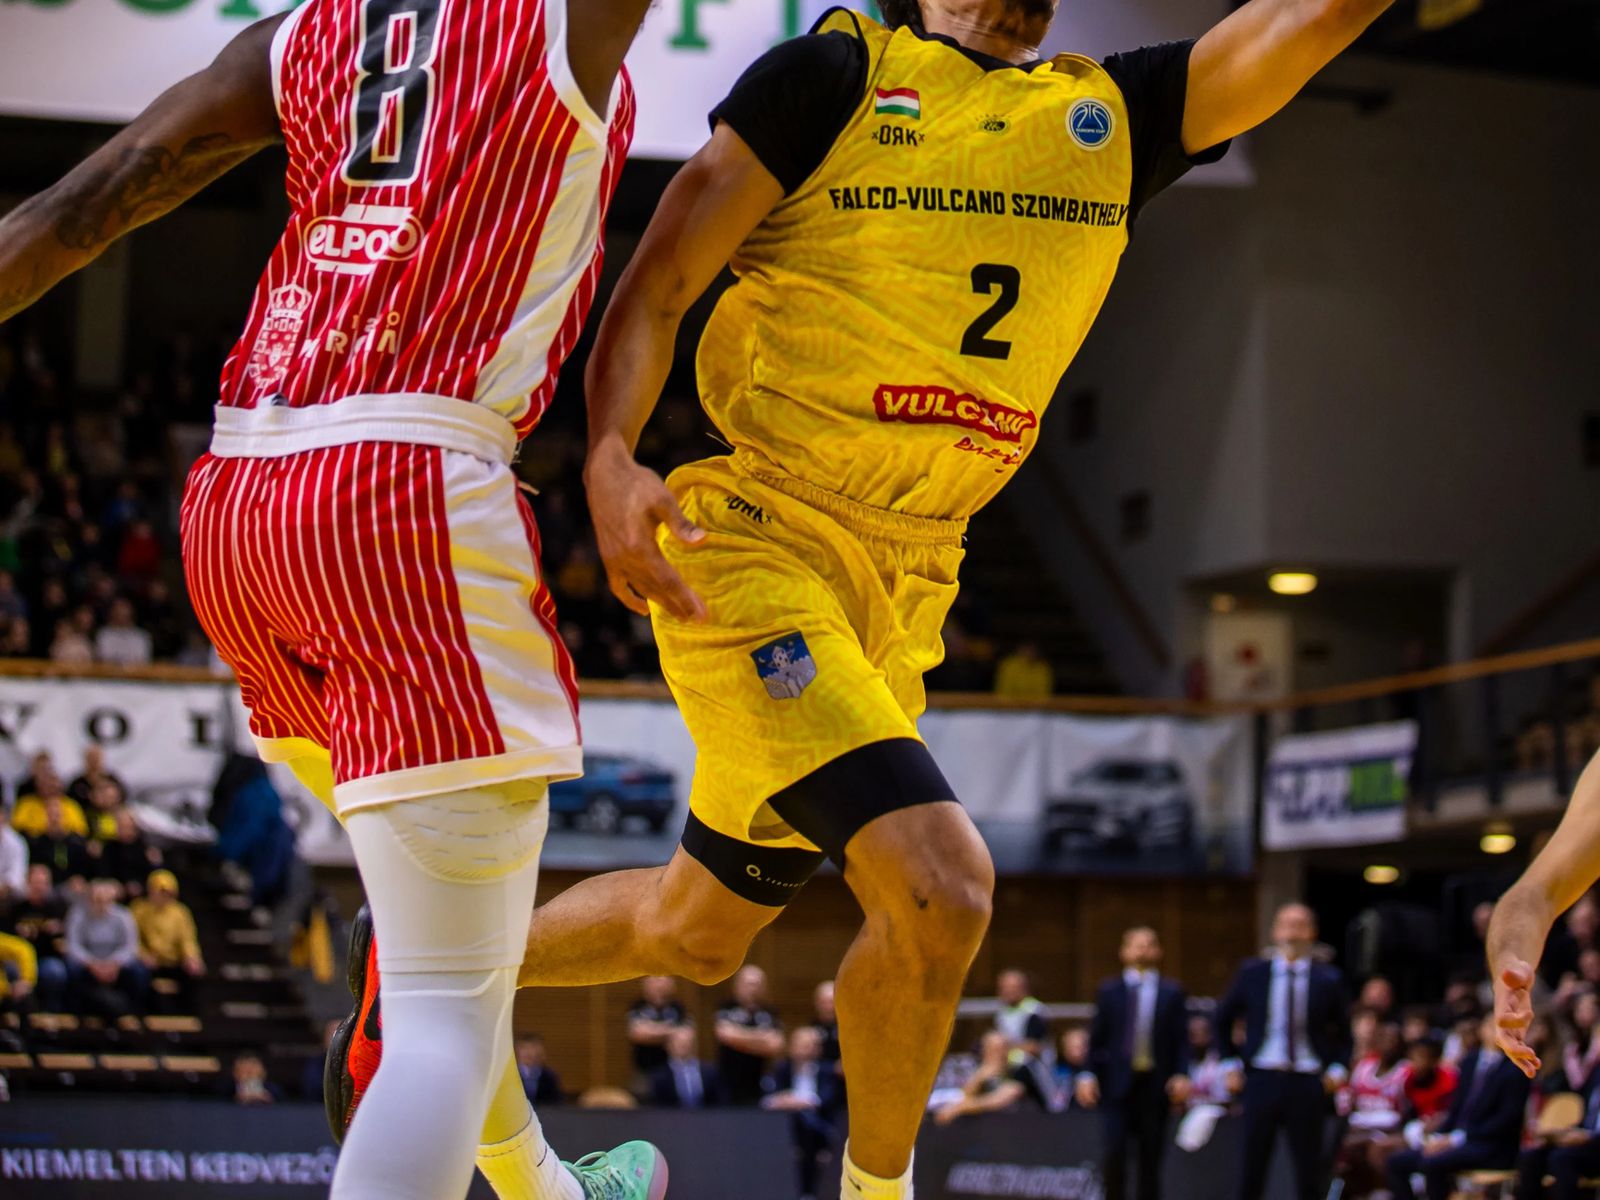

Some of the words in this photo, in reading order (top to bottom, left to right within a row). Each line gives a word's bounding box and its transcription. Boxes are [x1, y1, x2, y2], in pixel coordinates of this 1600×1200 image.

[829, 186, 1006, 215] FALCO-VULCANO
[1012, 193, 1129, 227] SZOMBATHELY
[960, 263, 1021, 360] 2
[2, 1148, 186, 1182] KIEMELTEN
